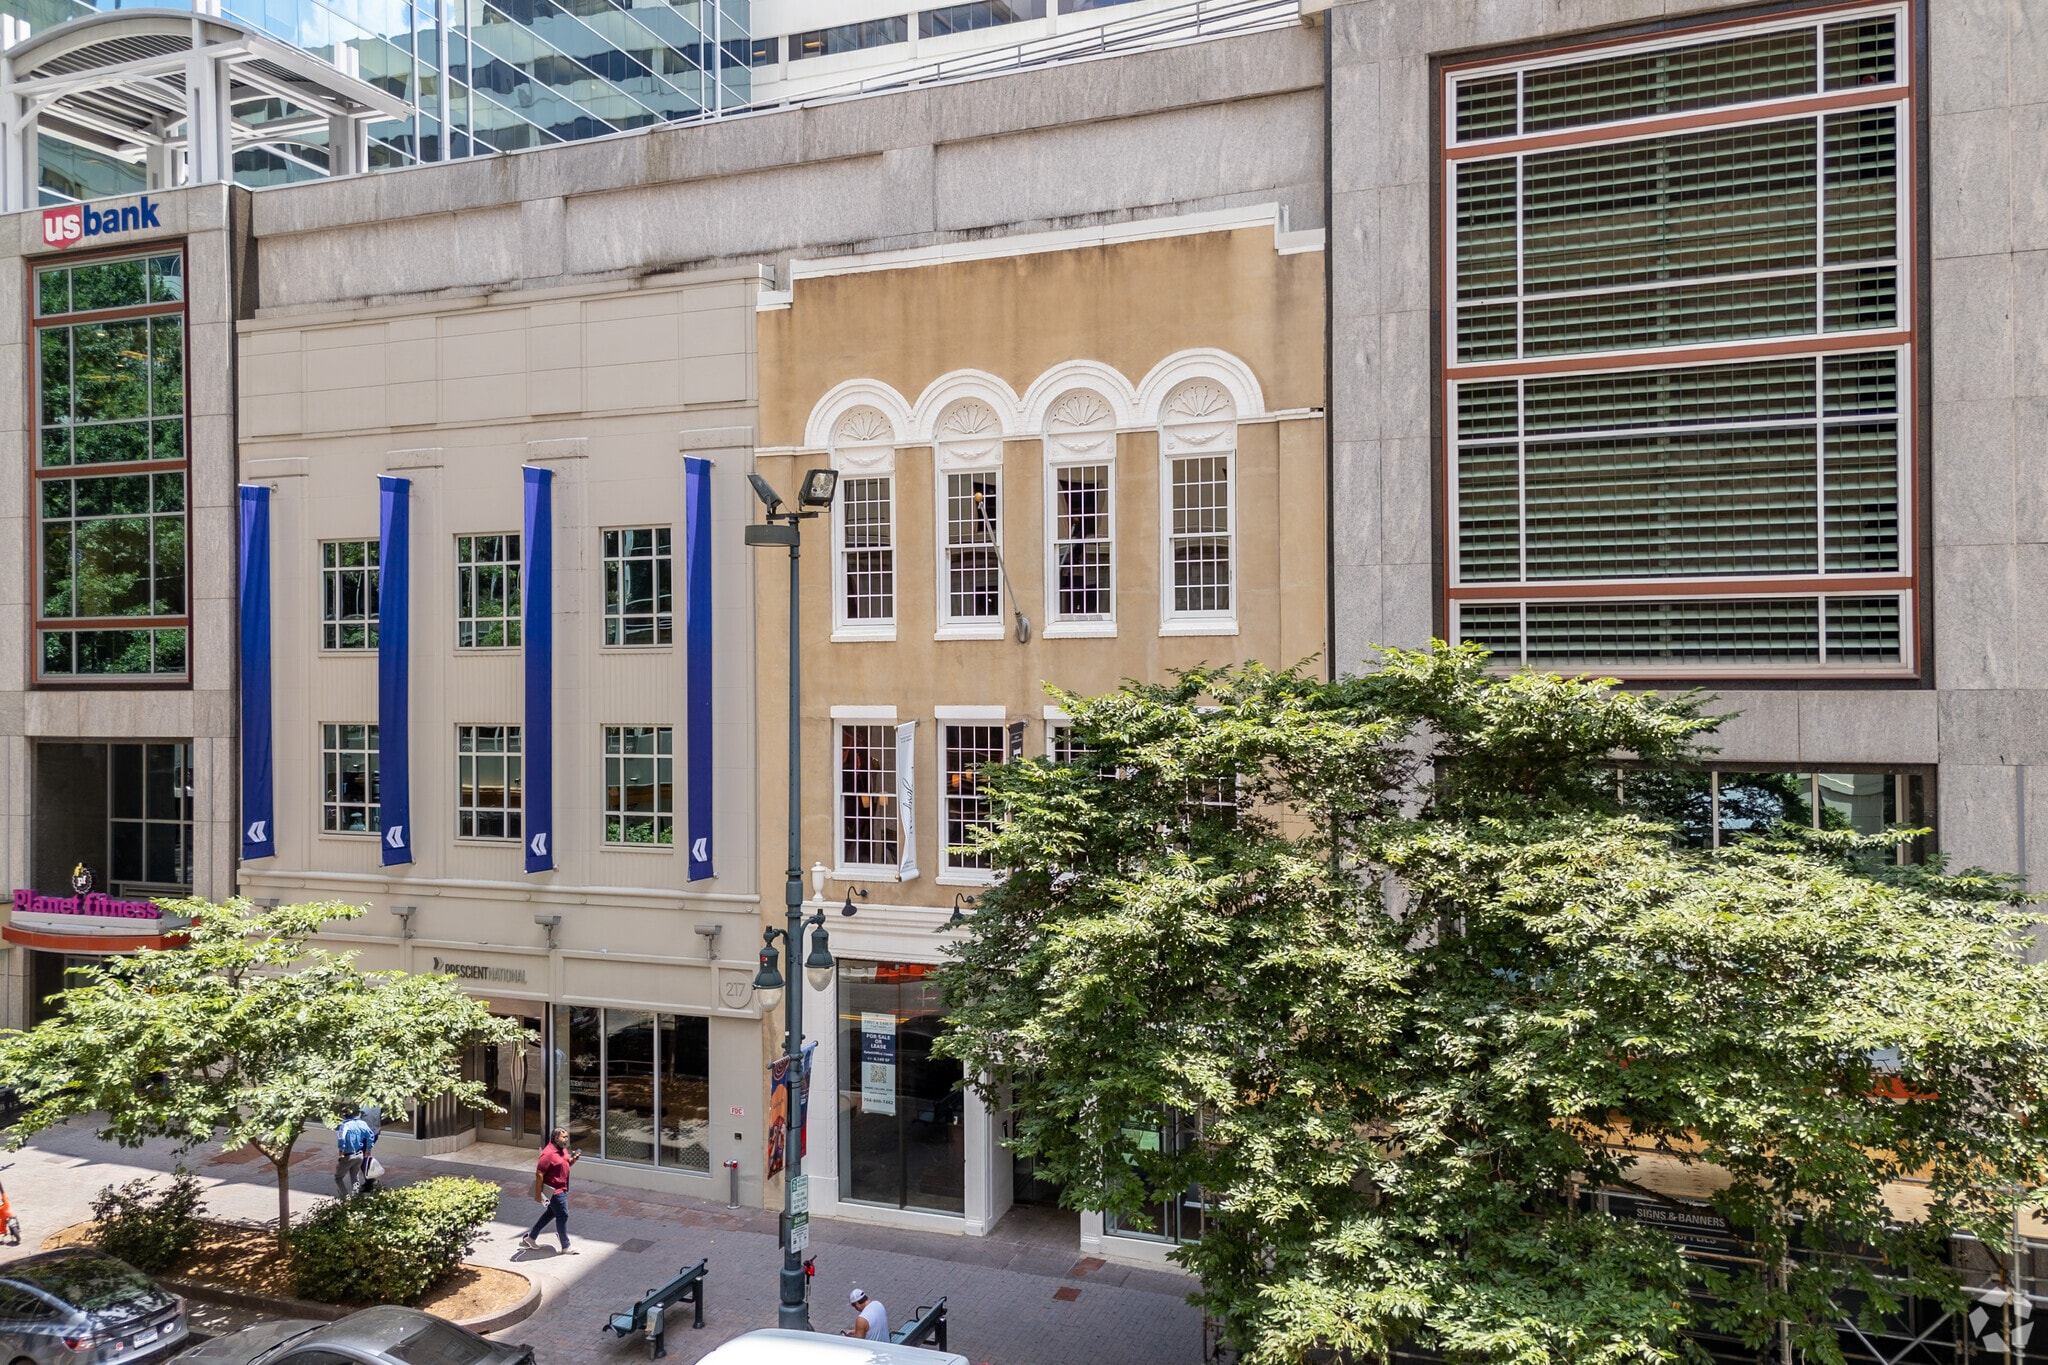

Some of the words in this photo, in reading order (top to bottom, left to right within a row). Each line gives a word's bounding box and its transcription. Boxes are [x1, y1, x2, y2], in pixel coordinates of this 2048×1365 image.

[13, 889, 83, 915] Planet
[84, 892, 160, 919] fitness
[725, 981, 746, 997] 217
[1636, 1208, 1666, 1221] SIGNS
[1668, 1212, 1677, 1221] &
[1678, 1213, 1726, 1228] BANNERS
